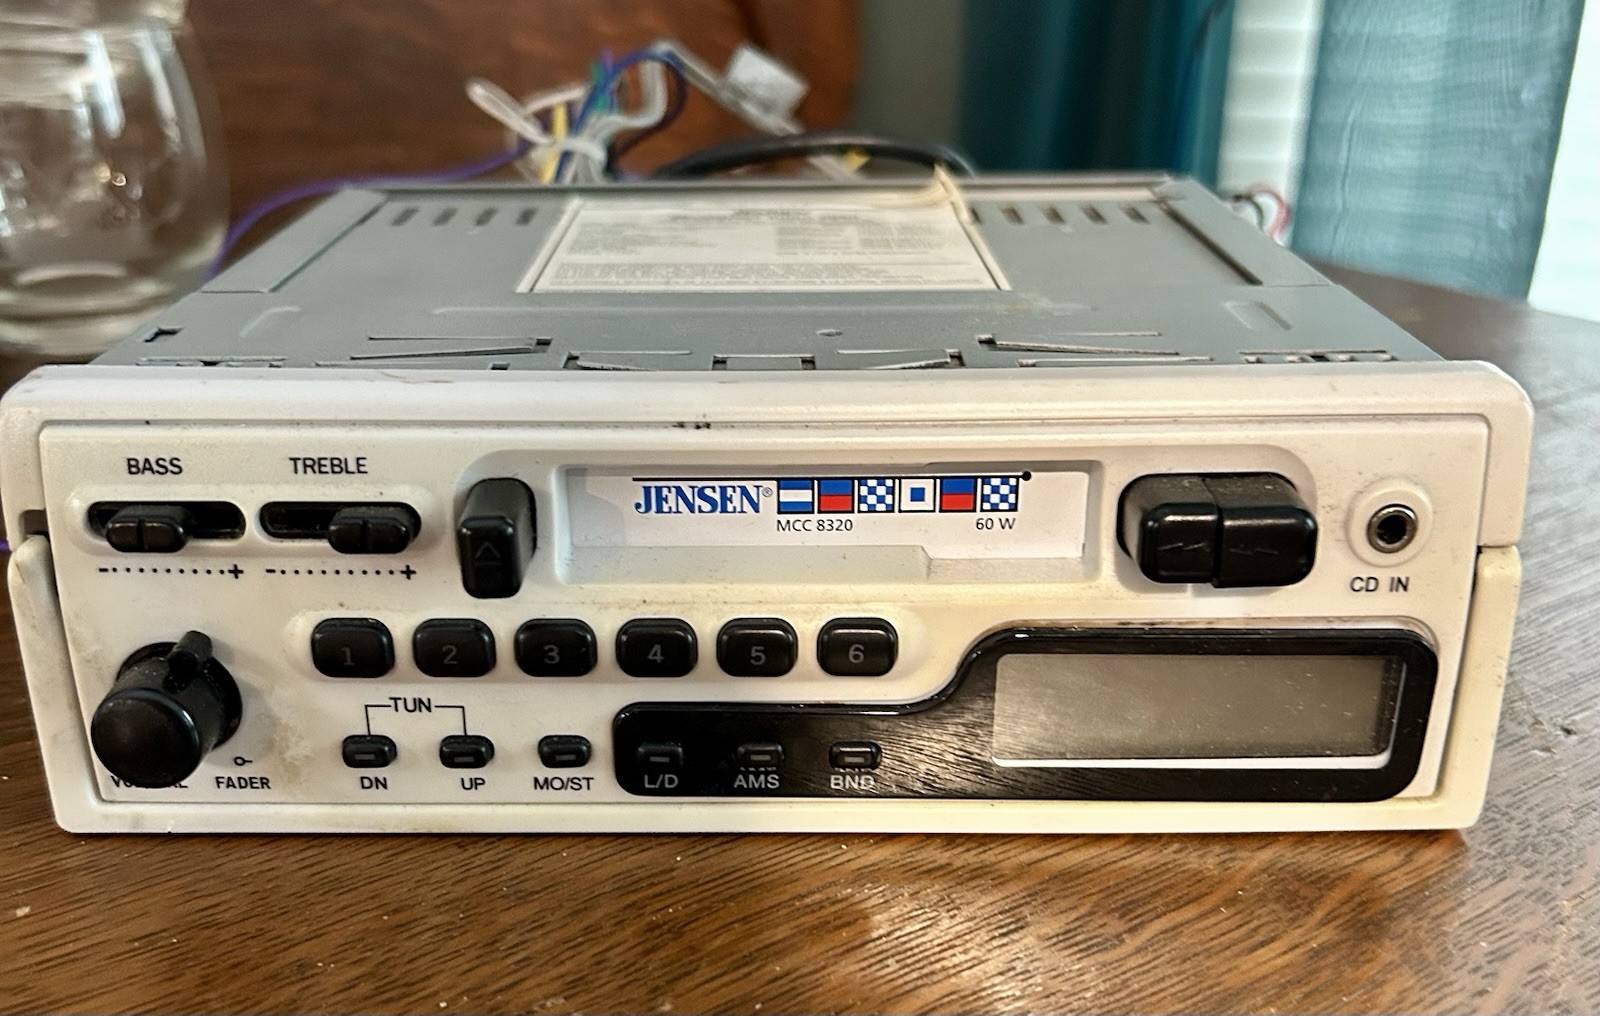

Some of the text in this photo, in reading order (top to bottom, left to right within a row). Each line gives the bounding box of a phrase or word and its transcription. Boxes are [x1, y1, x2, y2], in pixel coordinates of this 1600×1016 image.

[126, 457, 183, 475] BASS
[289, 457, 368, 474] TREBLE
[776, 518, 853, 532] MCC 8320
[975, 518, 1016, 531] 60 W
[1350, 576, 1409, 593] CD IN
[343, 647, 355, 666] 1
[442, 645, 458, 665] 2
[543, 644, 560, 664] 3
[647, 644, 664, 664] 4
[750, 646, 766, 666] 5
[848, 644, 865, 664] 6
[389, 697, 432, 713] TUN
[215, 776, 272, 790] FADER
[361, 776, 389, 790] DN
[460, 777, 486, 791] UP
[533, 776, 594, 791] MO/ST
[644, 774, 679, 789] L/D
[733, 774, 780, 789] AMS
[829, 774, 875, 790] BND
